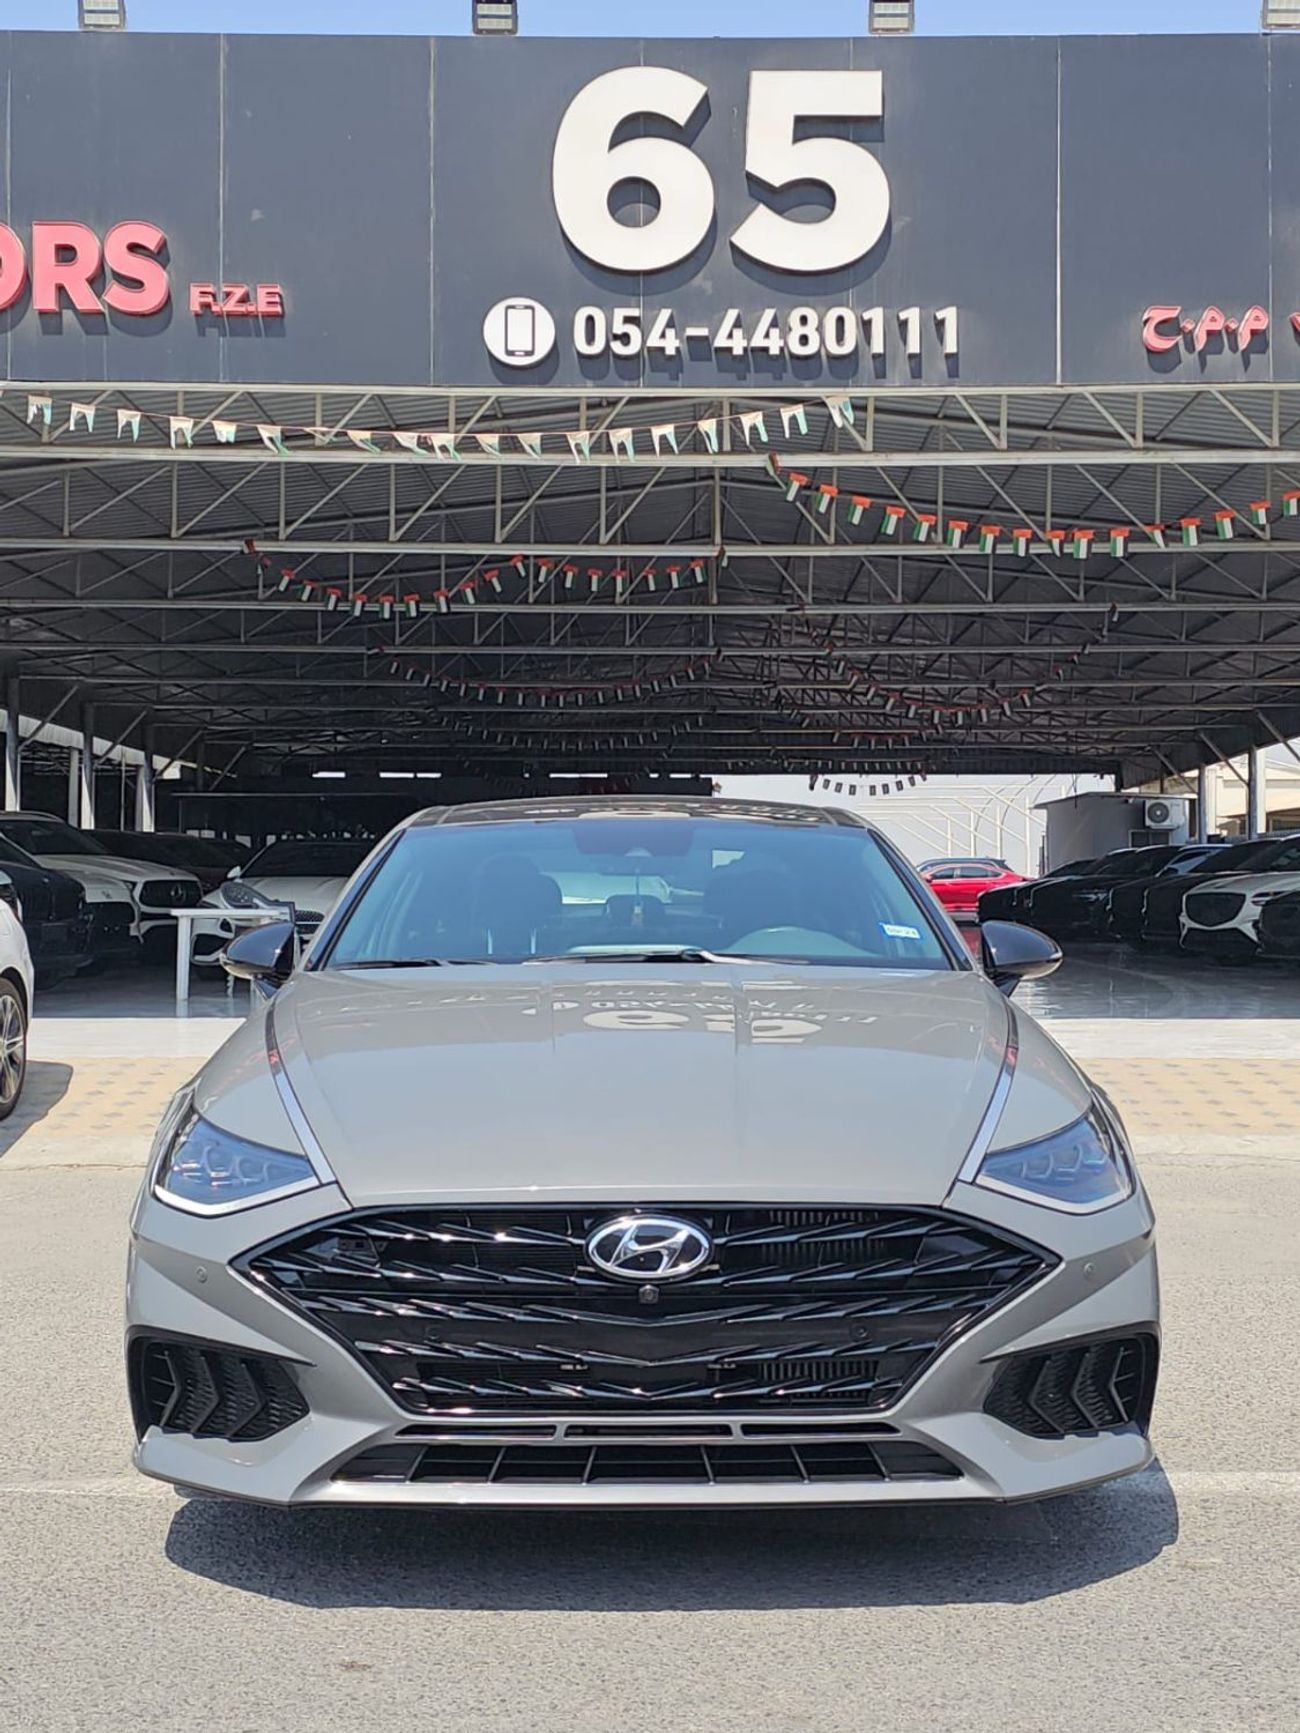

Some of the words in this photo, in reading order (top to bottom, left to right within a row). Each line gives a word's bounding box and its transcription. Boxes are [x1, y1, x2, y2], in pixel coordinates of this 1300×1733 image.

[552, 65, 891, 271] 65
[189, 282, 285, 317] F.Z.E
[573, 305, 959, 357] 054-4480111
